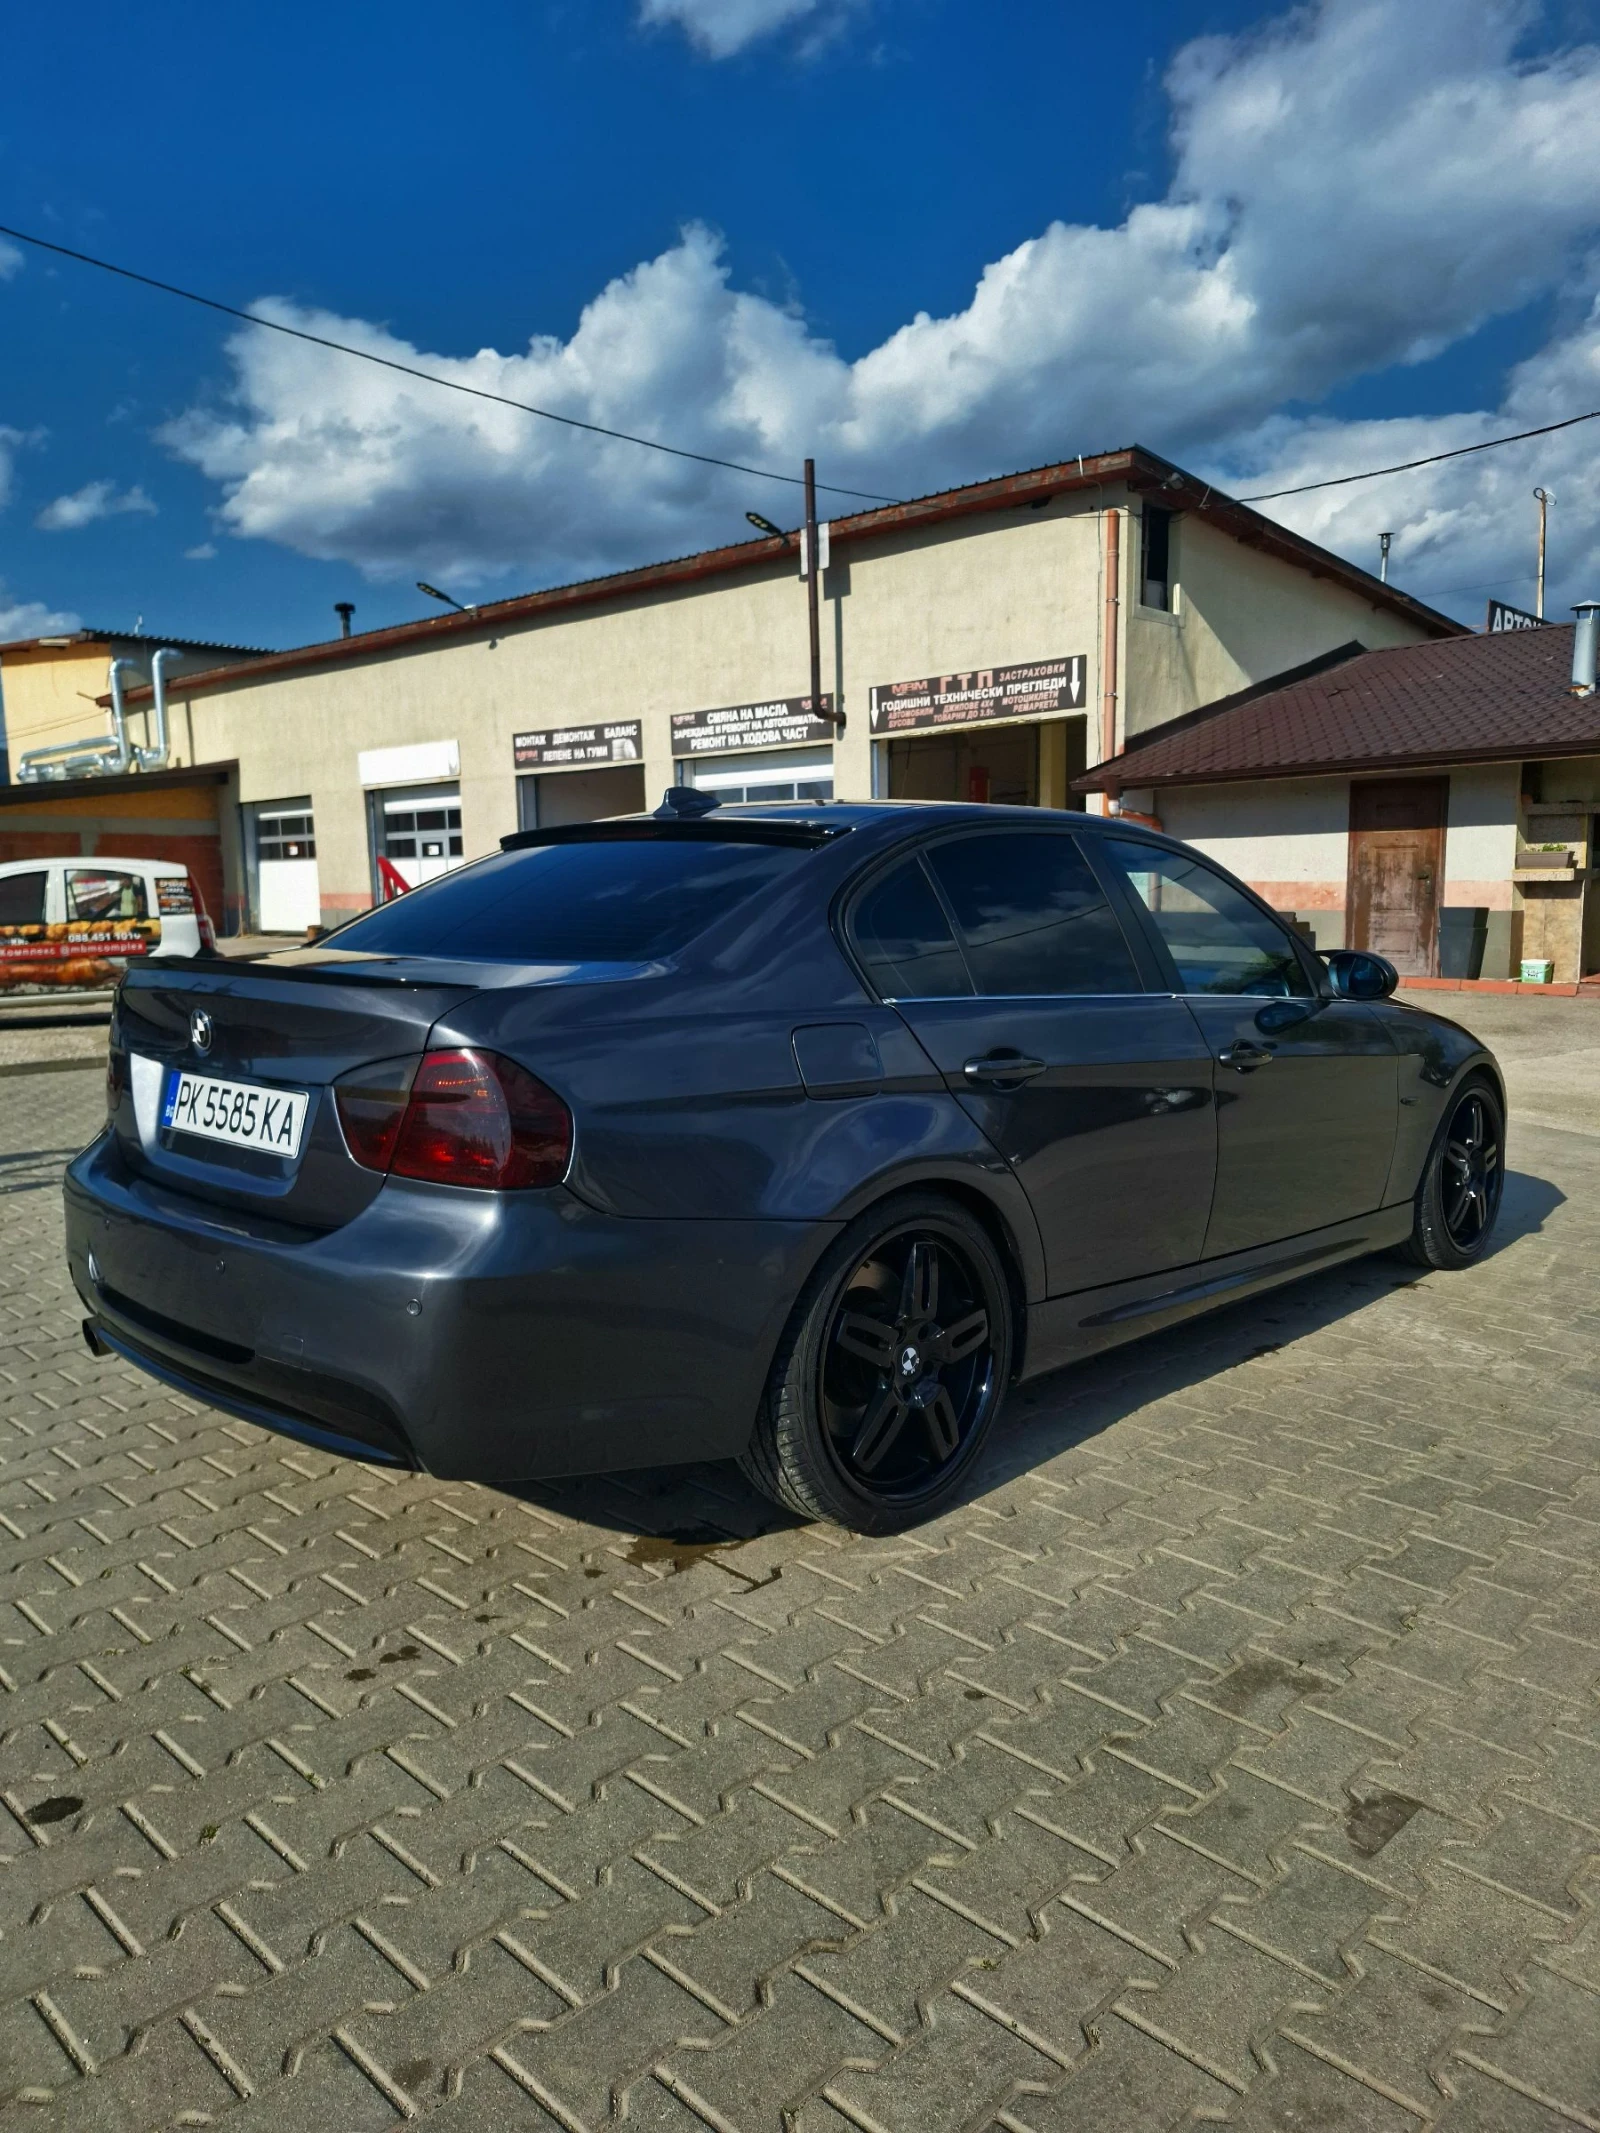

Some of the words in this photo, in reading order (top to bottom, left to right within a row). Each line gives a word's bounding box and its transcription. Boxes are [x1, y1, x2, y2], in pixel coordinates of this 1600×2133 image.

[999, 664, 1066, 682] ЗАСТРАХОВКИ
[881, 697, 931, 712] ГОДИШНИ
[933, 687, 1004, 706] ТЕХНИЧЕСКИ
[1006, 678, 1067, 696] ПРЕГЛЕДИ
[887, 708, 935, 720] АВТОМОБИЛИ
[942, 702, 980, 713] ДЖИПОВЕ
[1002, 691, 1059, 706] МОТОЦИКЛЕТИ
[707, 710, 739, 724] СМЯНА
[740, 708, 753, 720] НА
[754, 704, 788, 718] МАСЛА
[888, 719, 916, 729] БУСОВЕ
[934, 712, 967, 723] ТОВАРНИ
[966, 710, 979, 720] ДО
[1012, 701, 1059, 713] РЕМАРКЕТА
[515, 735, 546, 747] МОНТАЖ
[552, 730, 595, 745] ДЕМОНТАЖ
[604, 725, 637, 739] БАЛАНС
[673, 726, 714, 739] ЗАРЕЖДАНЕ
[715, 725, 721, 733] И
[721, 721, 751, 733] РЕМОНТ
[751, 719, 762, 730] НА
[690, 736, 726, 750] РЕМОНТ
[727, 733, 741, 746] НА
[742, 730, 781, 744] ХОДОВА
[782, 727, 808, 739] ЧАСТ
[542, 748, 572, 761] ЛЕПЕНЕ
[573, 747, 585, 759] НА
[586, 746, 608, 757] ГУМИ
